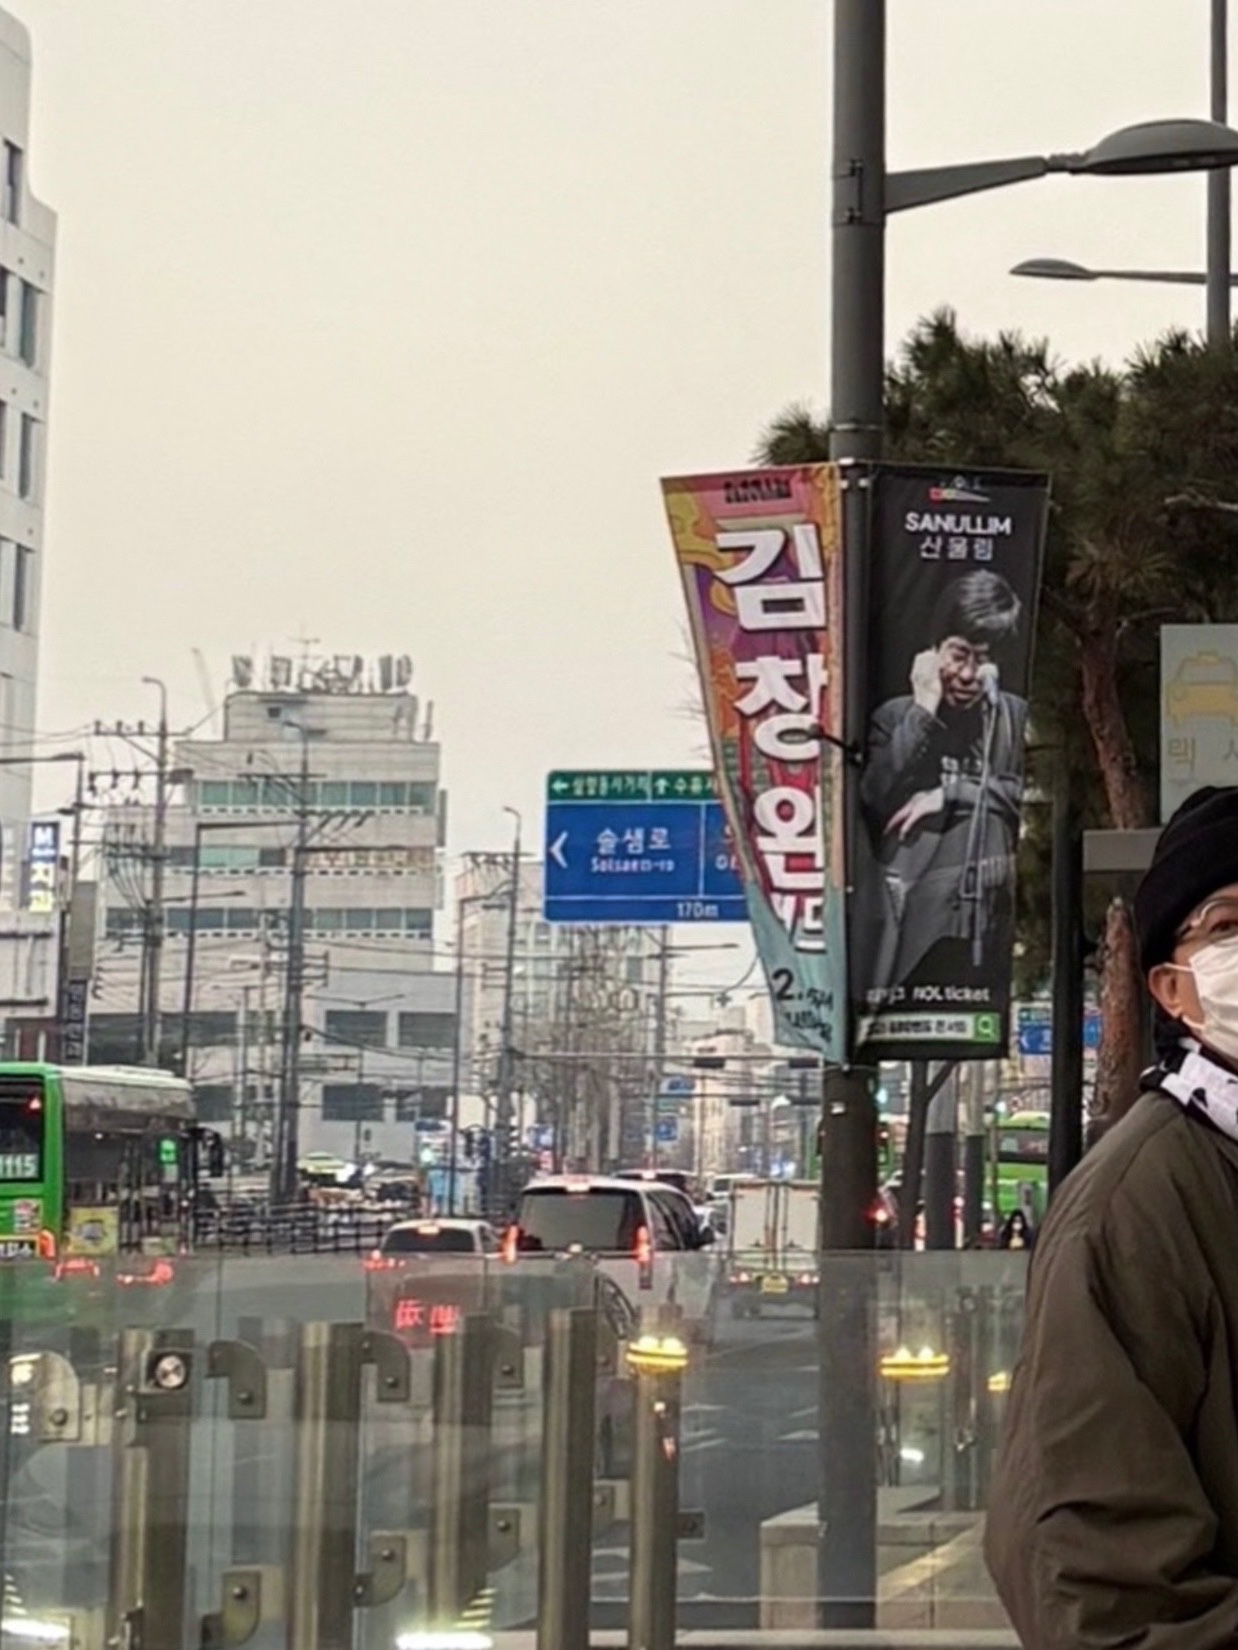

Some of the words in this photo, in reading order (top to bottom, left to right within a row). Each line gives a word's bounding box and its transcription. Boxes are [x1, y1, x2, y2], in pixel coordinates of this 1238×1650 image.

[905, 511, 1012, 535] SANULLIM
[920, 535, 993, 560] 산울림
[596, 827, 671, 854] 솔샘로
[676, 902, 719, 918] 170m
